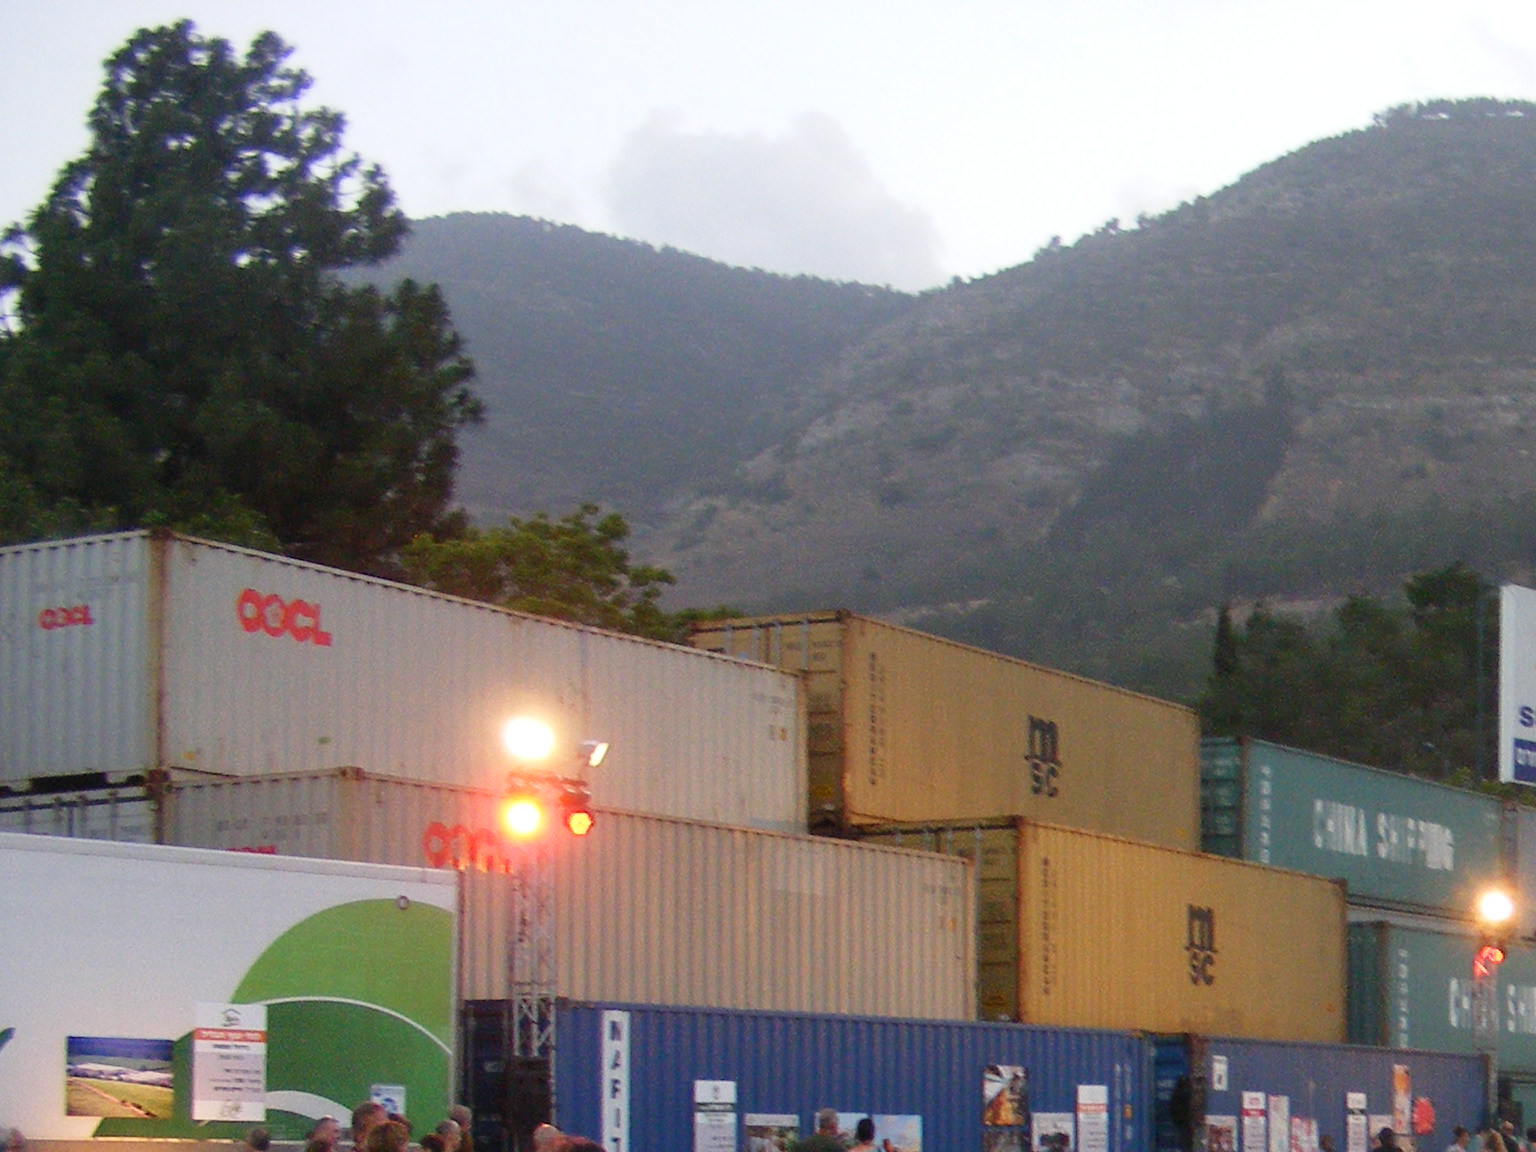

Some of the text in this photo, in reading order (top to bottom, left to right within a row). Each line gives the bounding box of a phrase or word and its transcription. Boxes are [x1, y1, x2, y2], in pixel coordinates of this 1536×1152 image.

[38, 604, 94, 631] OOCL
[236, 588, 332, 646] OOCL
[1313, 798, 1368, 857] CHINA
